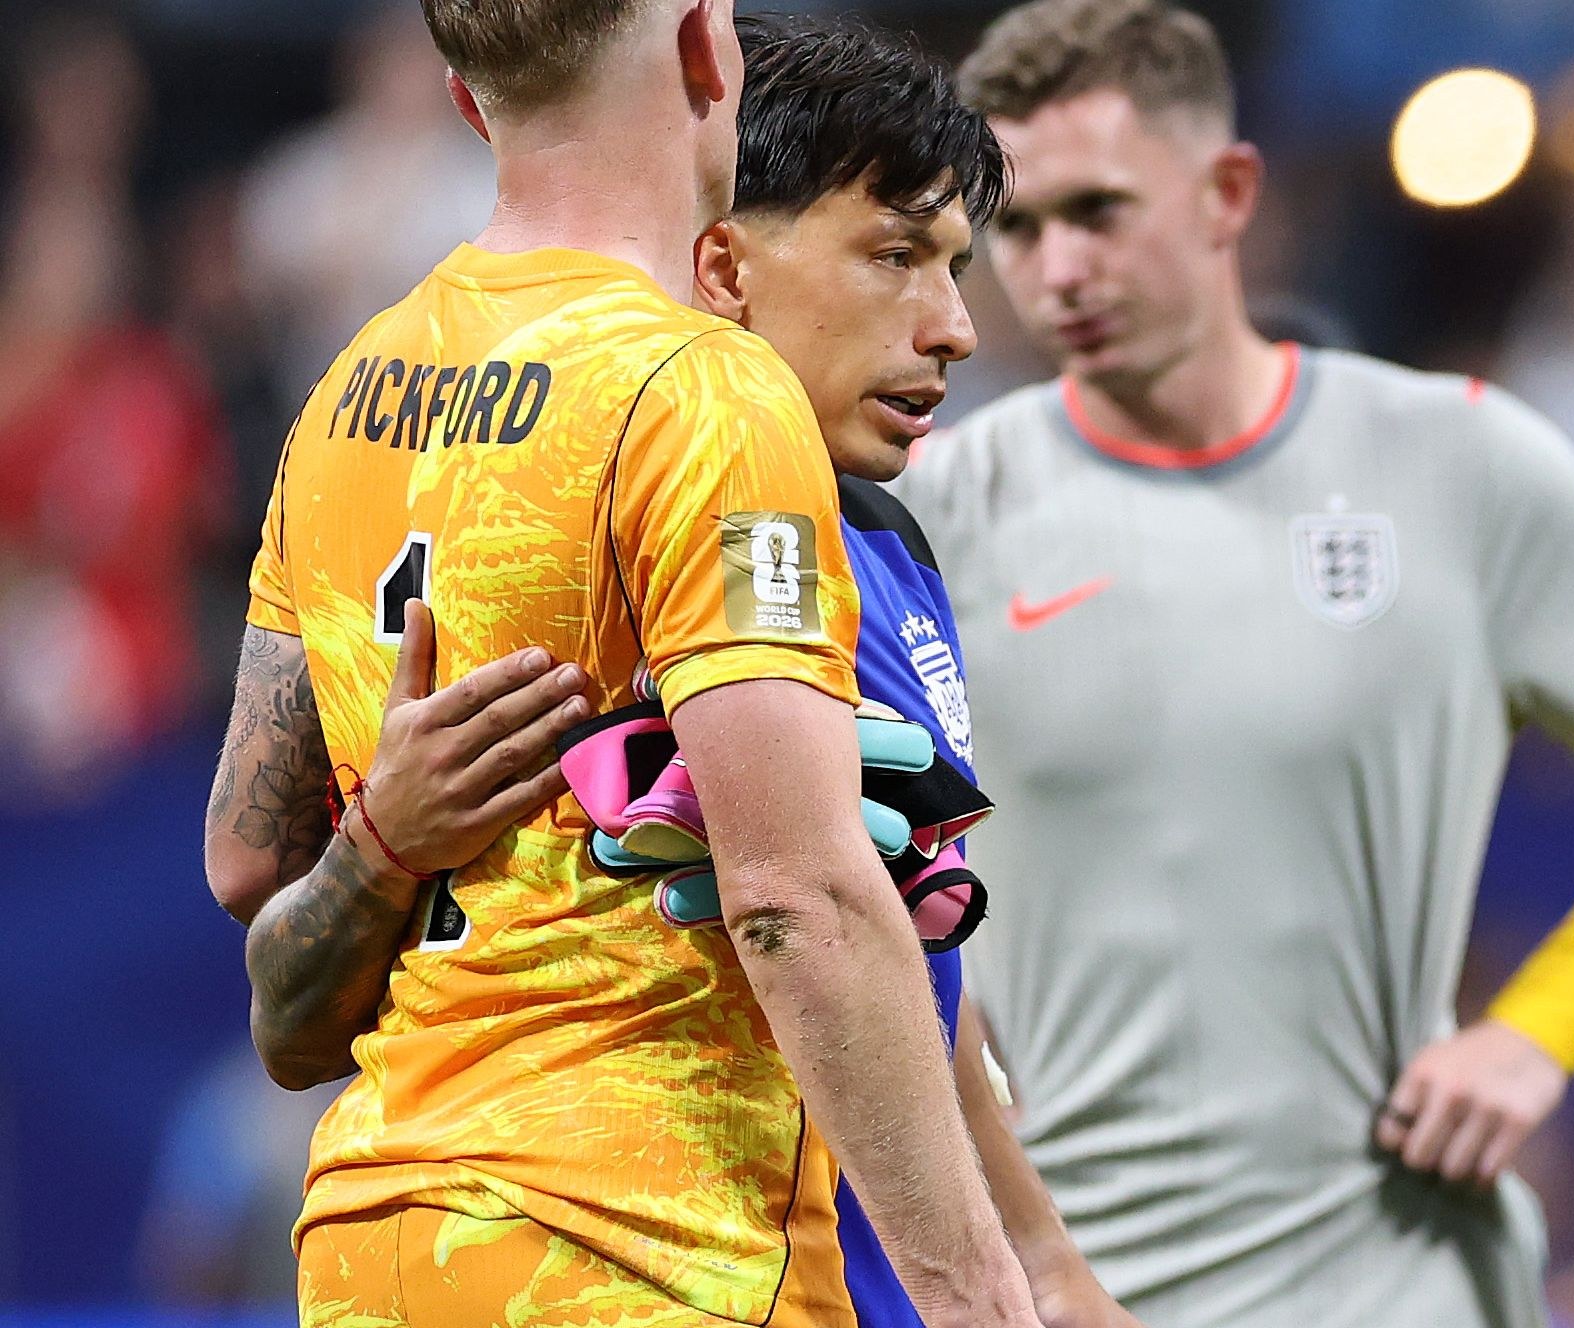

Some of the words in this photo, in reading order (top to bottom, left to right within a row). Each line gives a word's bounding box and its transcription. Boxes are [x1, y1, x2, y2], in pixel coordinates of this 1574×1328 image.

[327, 355, 552, 453] PICKFORD
[769, 586, 790, 596] FIFA
[755, 605, 787, 614] WORLD
[787, 606, 801, 616] CUP
[755, 614, 803, 629] 2026
